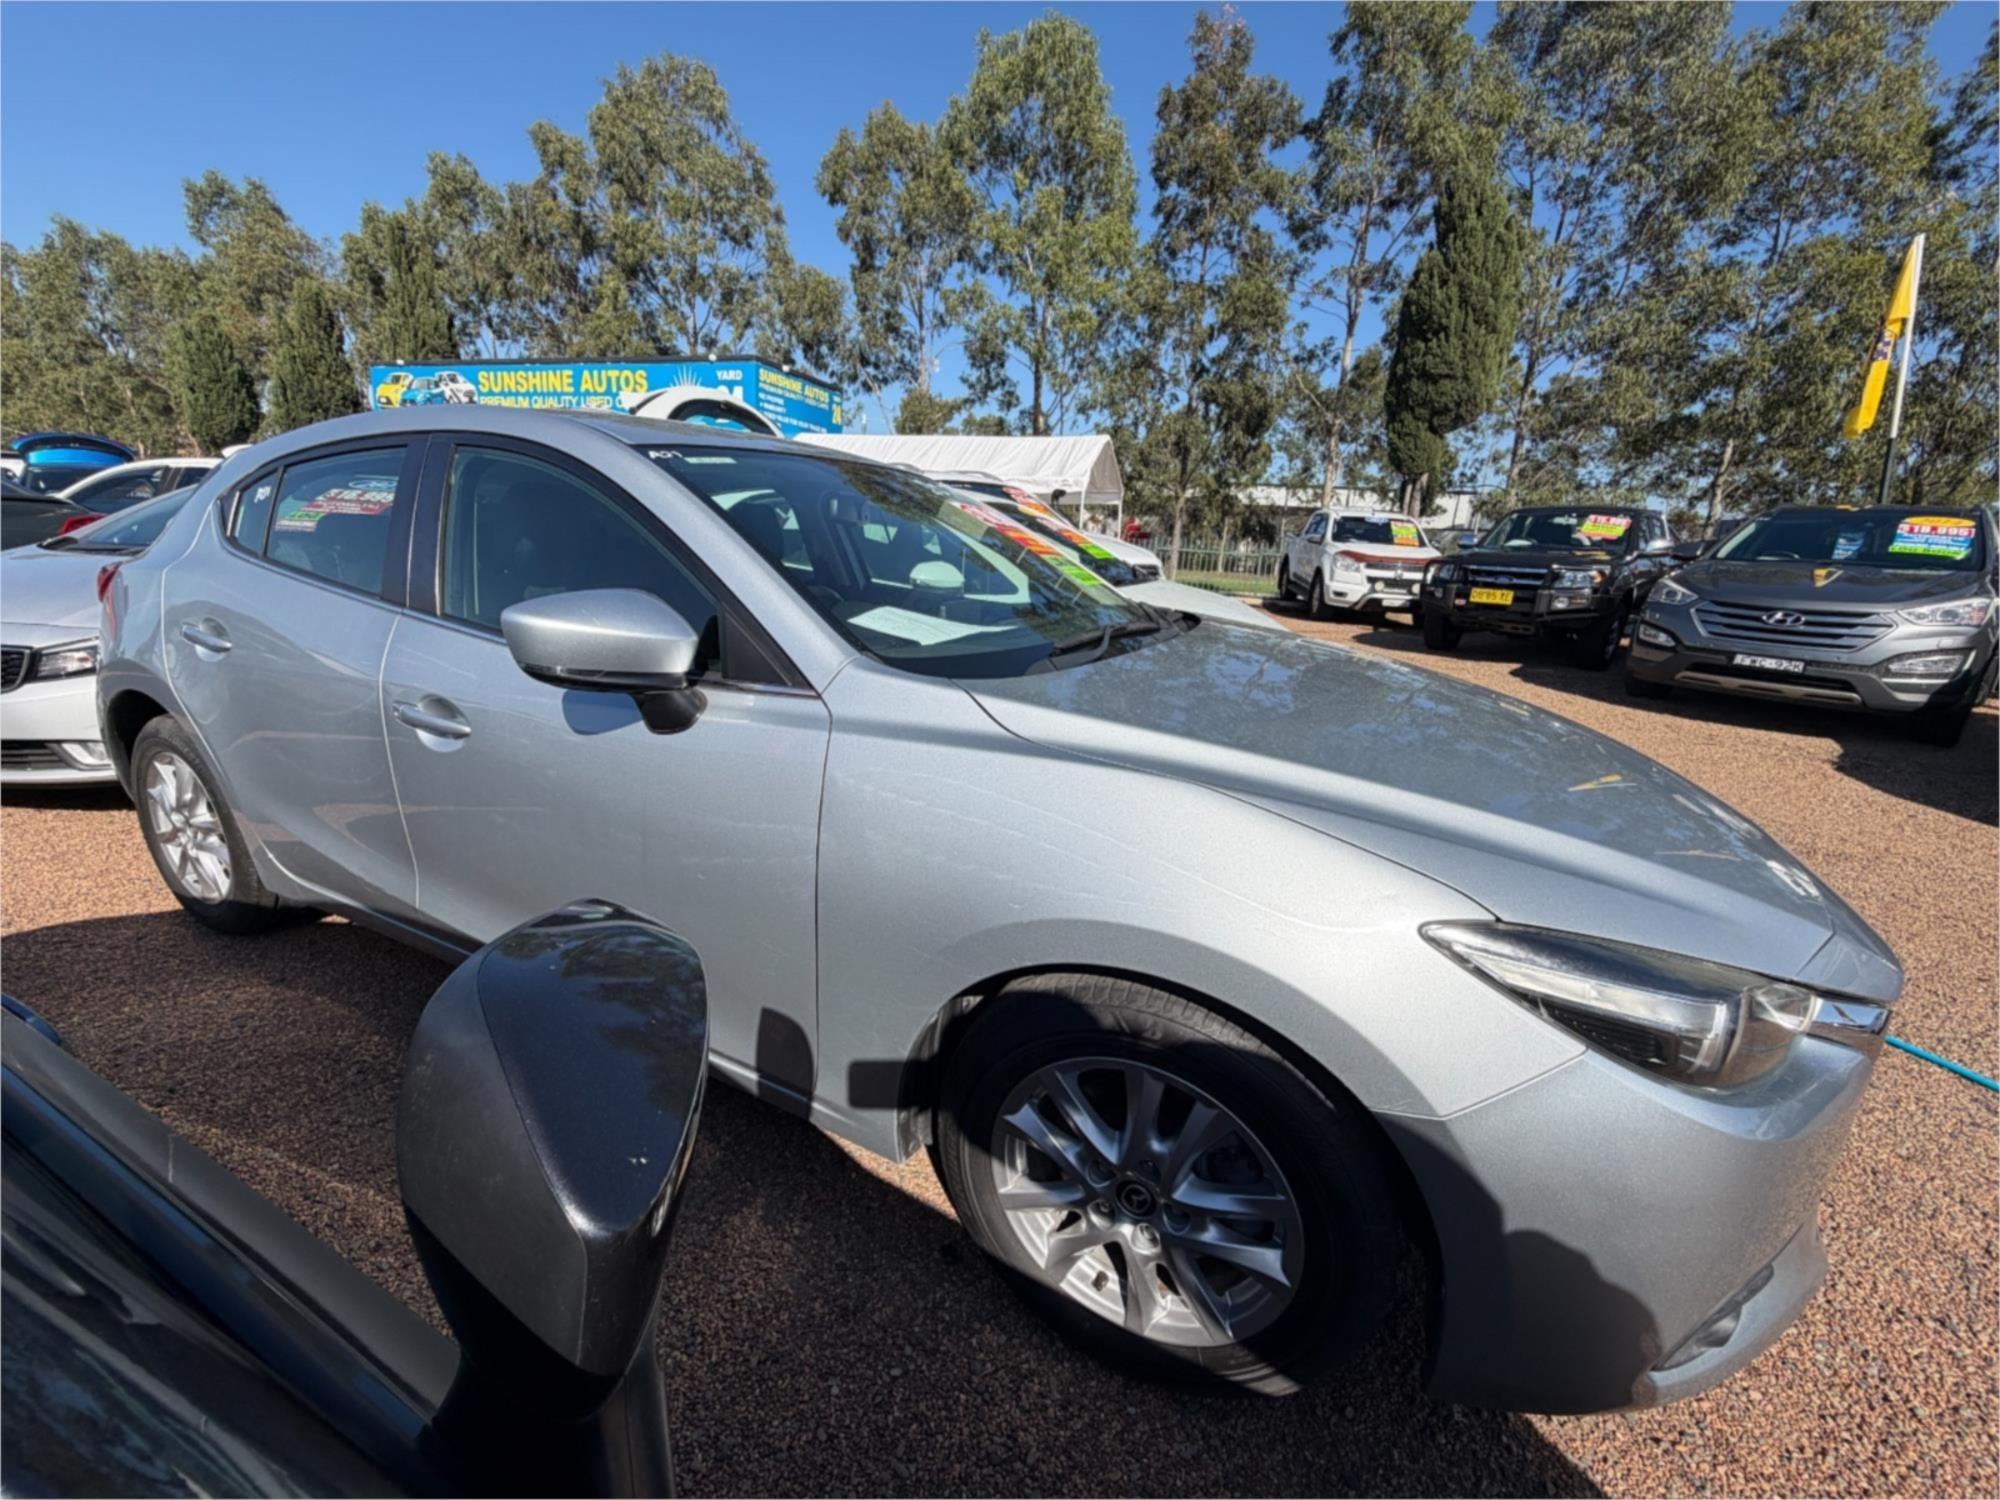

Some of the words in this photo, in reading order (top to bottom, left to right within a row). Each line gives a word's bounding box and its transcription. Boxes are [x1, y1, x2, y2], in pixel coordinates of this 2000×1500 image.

[478, 370, 575, 393] SUNSHINE
[580, 369, 648, 393] AUTOS
[716, 369, 743, 381] YARD
[759, 368, 803, 394] SUNSHINE
[804, 384, 829, 404] AUTOS
[480, 395, 529, 408] PREMIUM
[531, 396, 578, 411] QUALITY
[581, 396, 613, 410] USED
